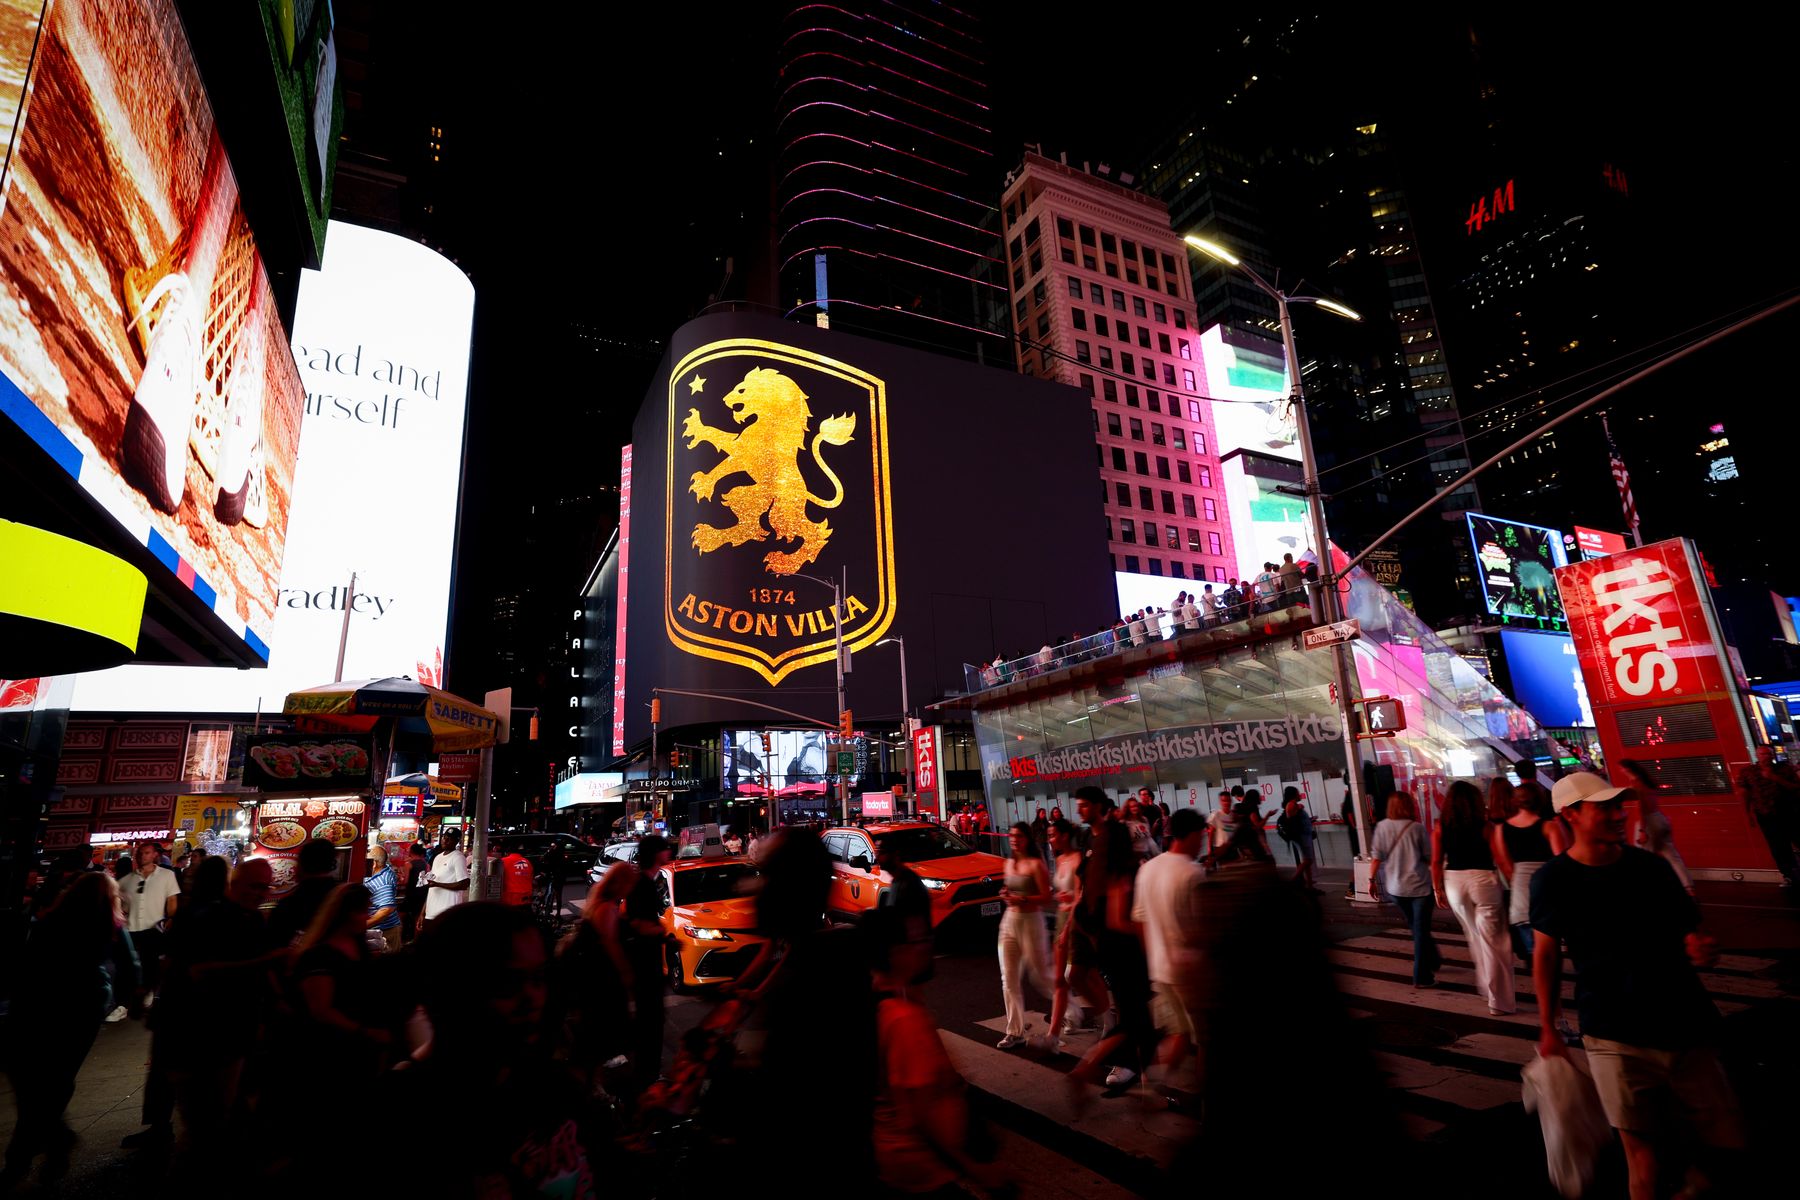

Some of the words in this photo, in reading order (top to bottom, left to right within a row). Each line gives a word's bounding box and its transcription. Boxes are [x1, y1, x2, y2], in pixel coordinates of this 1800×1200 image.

[1464, 178, 1516, 237] H&M
[373, 359, 440, 400] and
[1565, 543, 1577, 551] LG
[749, 588, 796, 605] 1874
[677, 593, 778, 637] ASTON
[784, 595, 869, 637] VILLA
[1311, 633, 1328, 643] ONE
[1333, 628, 1351, 638] WAY
[1591, 557, 1683, 697] tkts
[433, 702, 494, 730] SABRETT
[918, 731, 932, 788] tkts
[639, 780, 669, 788] TEMPO
[1190, 788, 1197, 799] 8
[1260, 783, 1273, 795] 10
[260, 803, 304, 817] HALAL
[328, 801, 365, 815] FOOD
